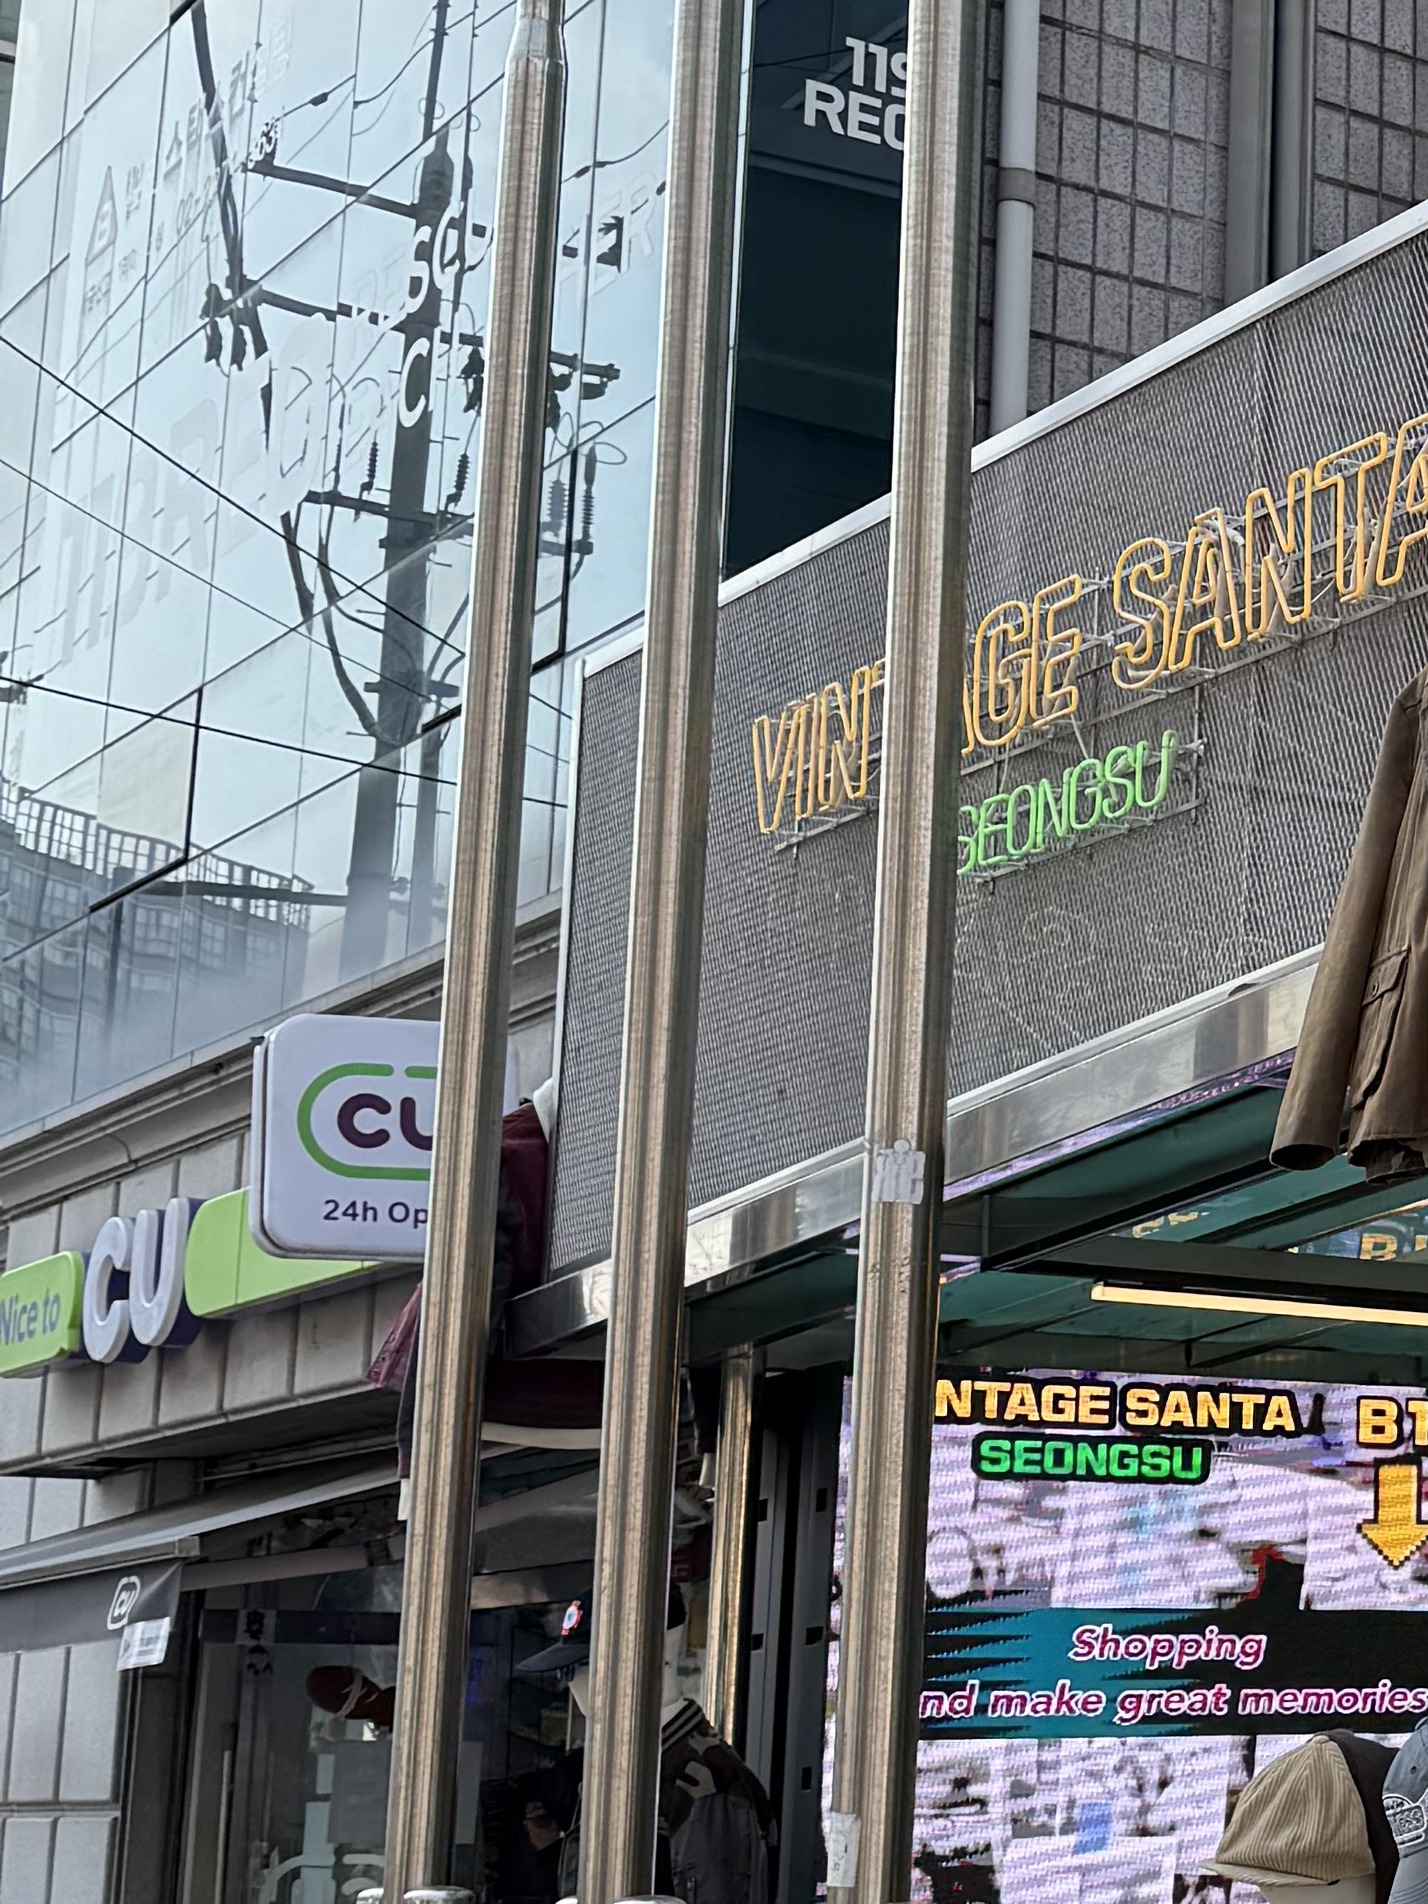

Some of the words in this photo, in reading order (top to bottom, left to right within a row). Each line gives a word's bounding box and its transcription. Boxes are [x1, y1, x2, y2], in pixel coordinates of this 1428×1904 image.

[753, 575, 1083, 836] VINGE
[322, 1198, 379, 1224] 24h
[388, 1200, 429, 1231] Op
[82, 1197, 192, 1364] CU
[42, 1286, 60, 1335] to
[934, 1377, 1112, 1426] NTAGE
[1125, 1387, 1298, 1434] SANTA
[978, 1440, 1204, 1480] SEONGSU
[1069, 1624, 1267, 1670] Shopping
[919, 1681, 977, 1720] nd
[988, 1680, 1105, 1719] make
[1114, 1683, 1230, 1724] great
